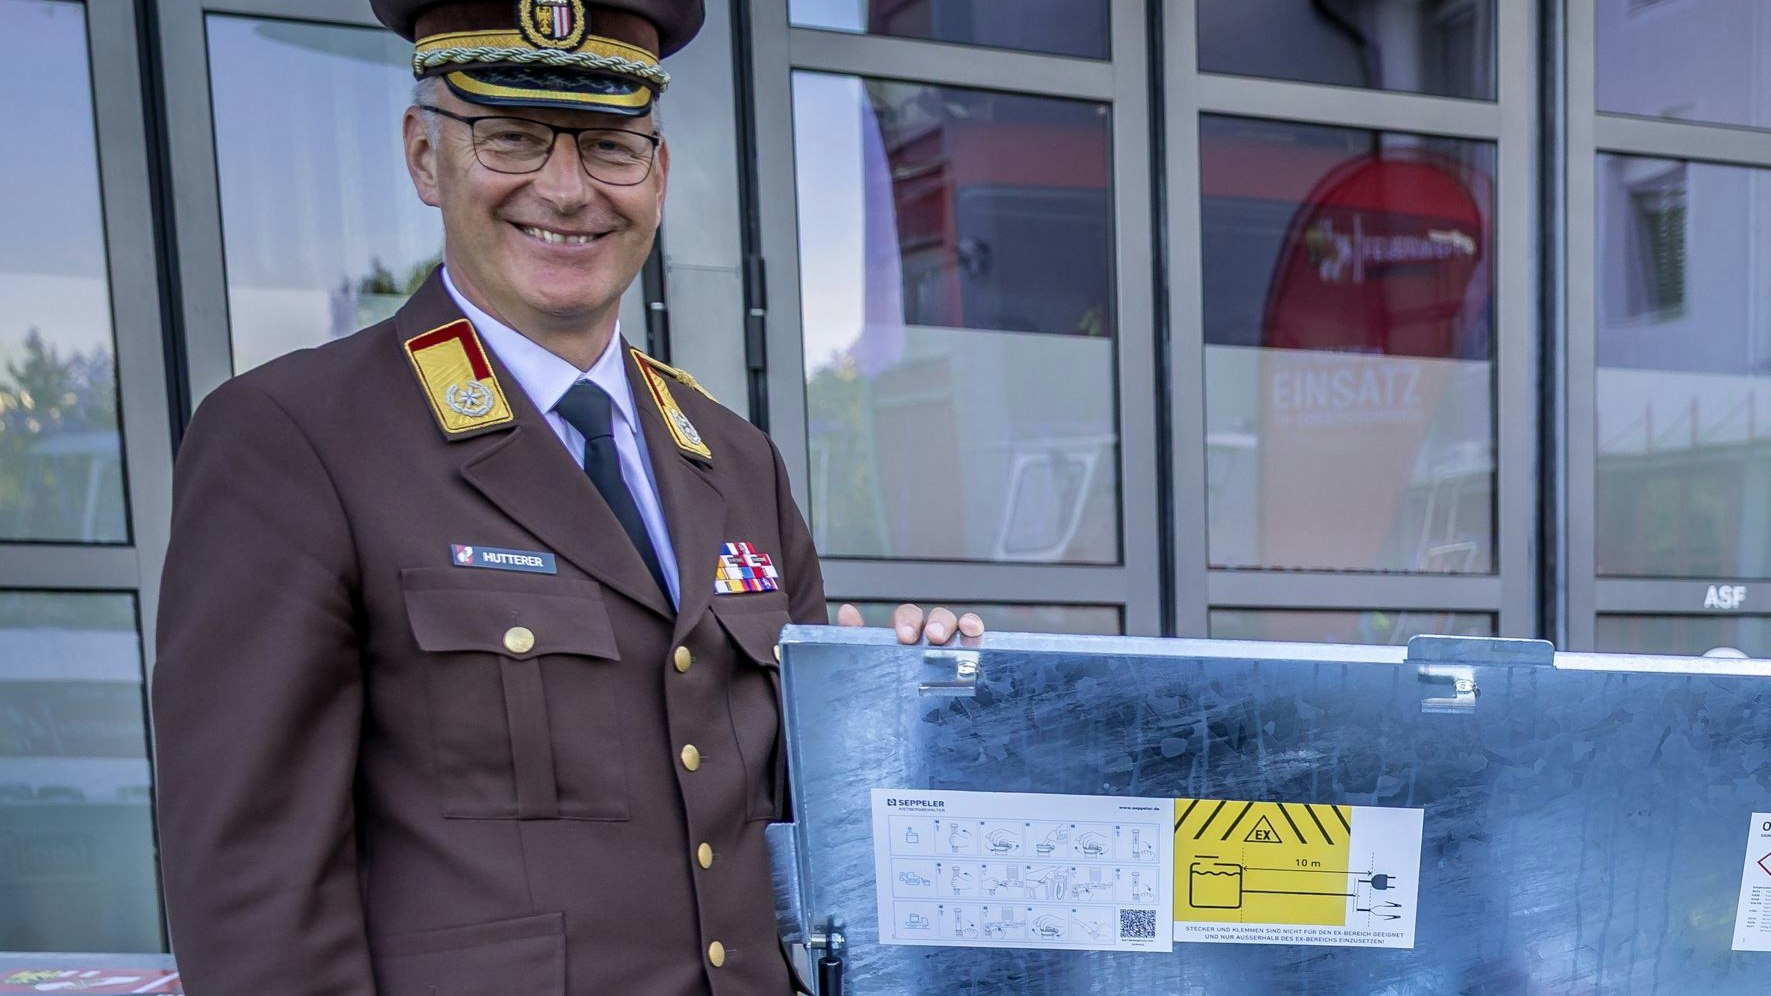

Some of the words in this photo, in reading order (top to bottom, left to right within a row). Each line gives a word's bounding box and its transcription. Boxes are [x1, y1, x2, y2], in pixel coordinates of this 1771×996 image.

[1273, 364, 1421, 407] EINSATZ
[482, 552, 544, 568] HUTTERER
[1704, 585, 1747, 609] ASF
[898, 799, 945, 808] SEPPELER
[1255, 830, 1271, 841] EX
[1295, 859, 1308, 867] 10
